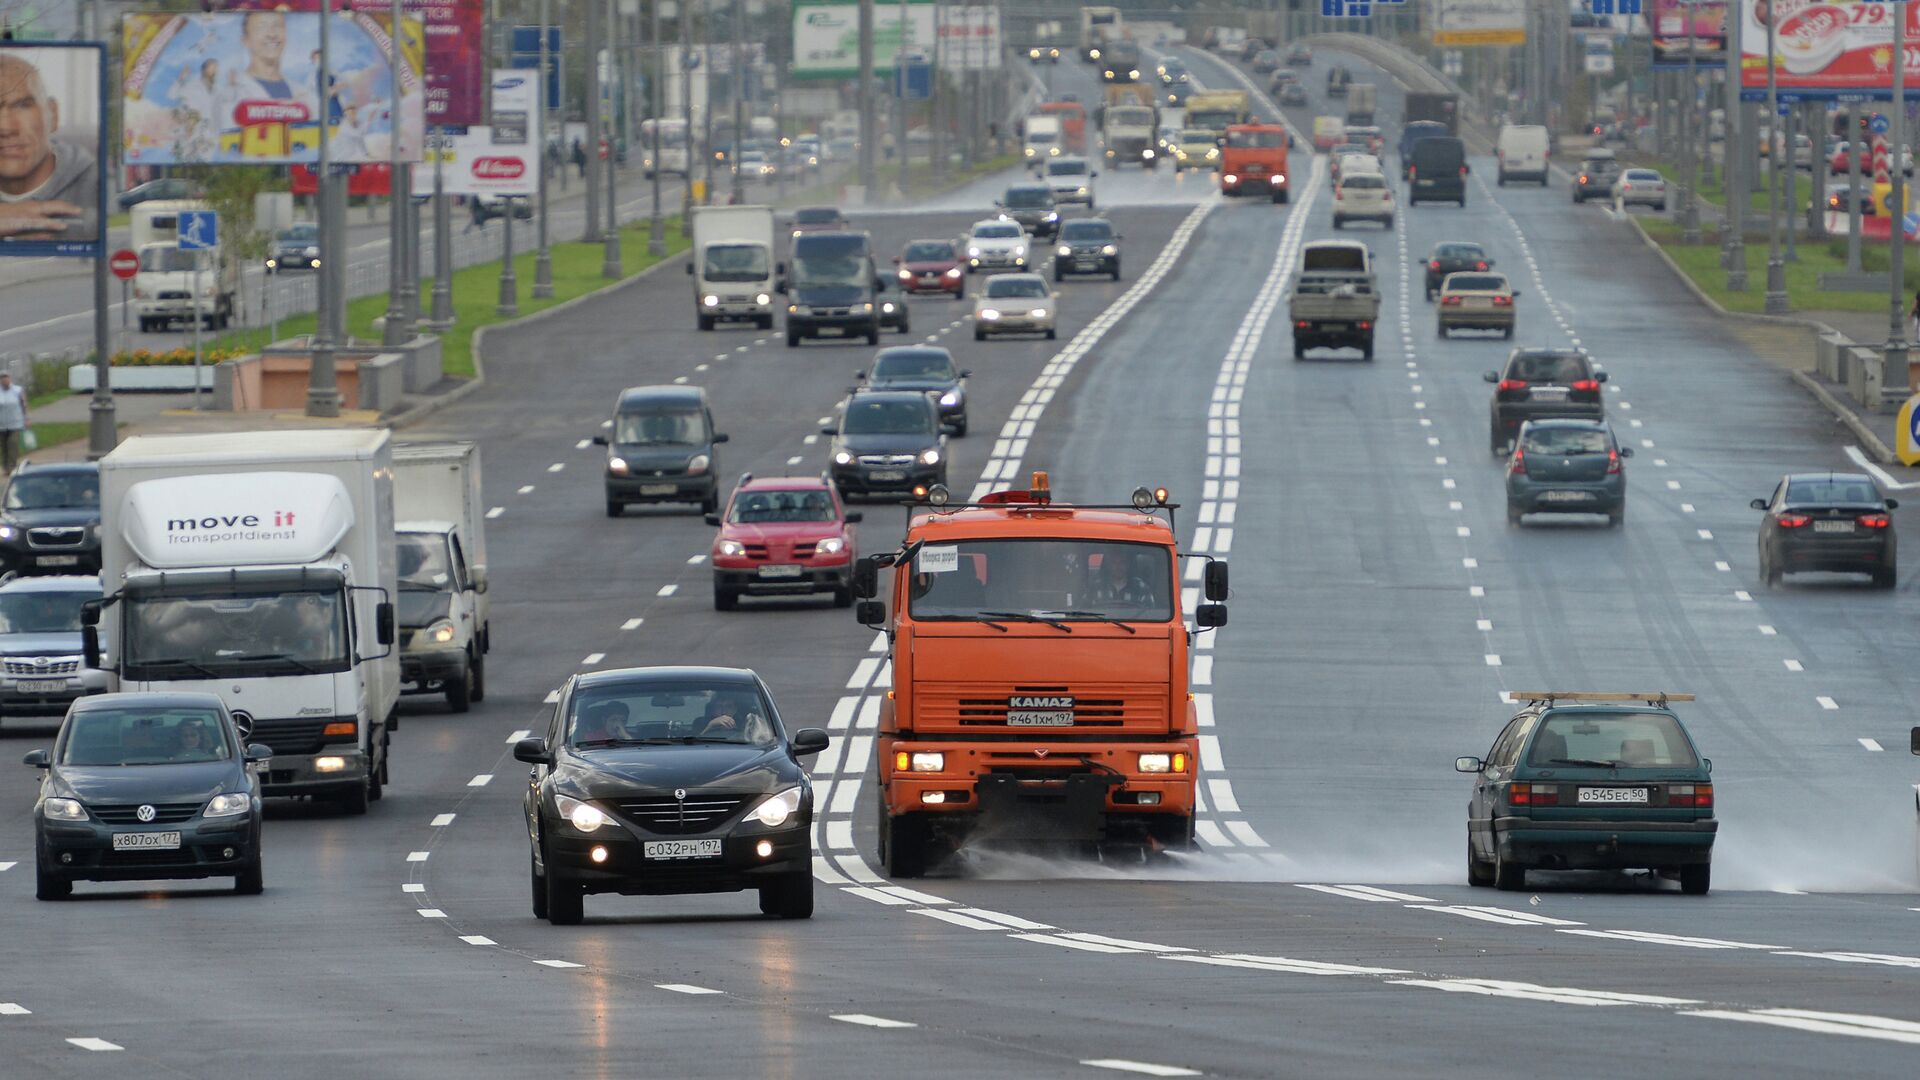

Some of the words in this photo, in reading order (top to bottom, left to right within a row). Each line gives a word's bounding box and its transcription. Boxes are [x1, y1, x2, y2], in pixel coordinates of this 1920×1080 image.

[167, 516, 259, 530] move
[275, 511, 295, 527] it
[168, 531, 295, 543] Transportdienst
[1010, 697, 1072, 707] KAMAZ
